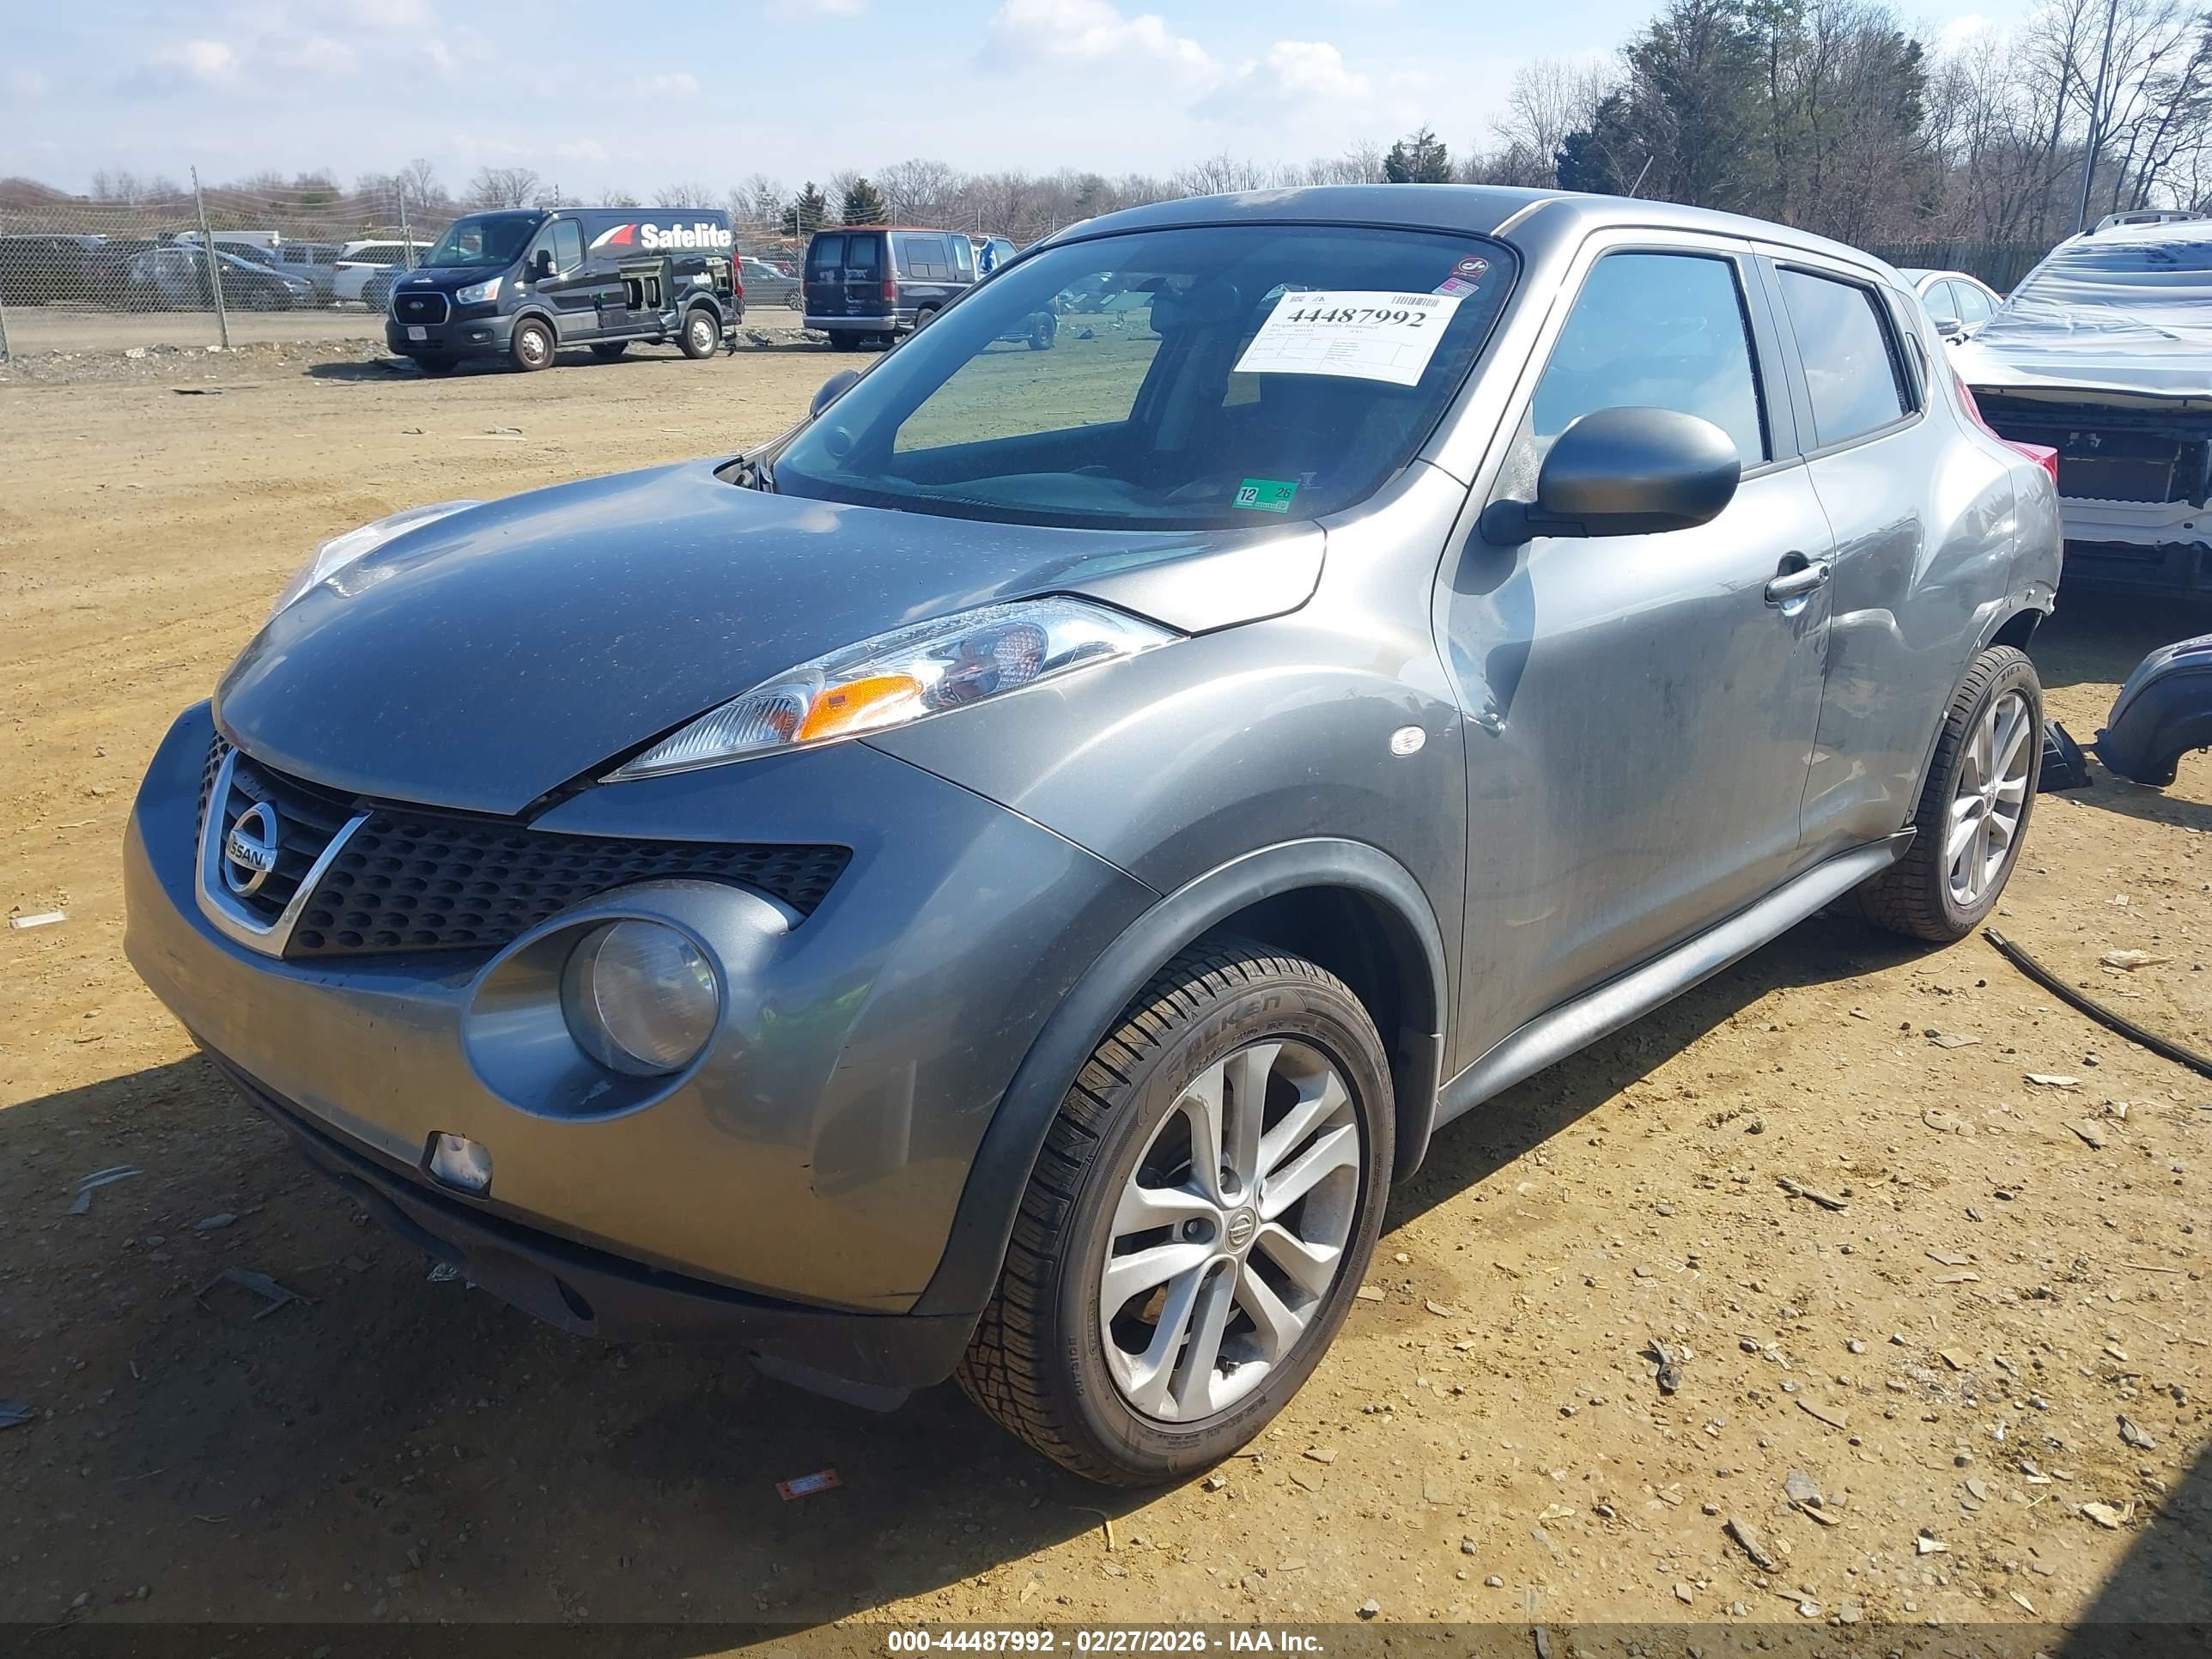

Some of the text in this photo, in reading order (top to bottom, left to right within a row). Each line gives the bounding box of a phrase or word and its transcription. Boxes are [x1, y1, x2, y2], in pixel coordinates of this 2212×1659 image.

[641, 222, 732, 248] Safelite
[1288, 308, 1426, 328] 44487992
[1240, 487, 1291, 501] 12 26
